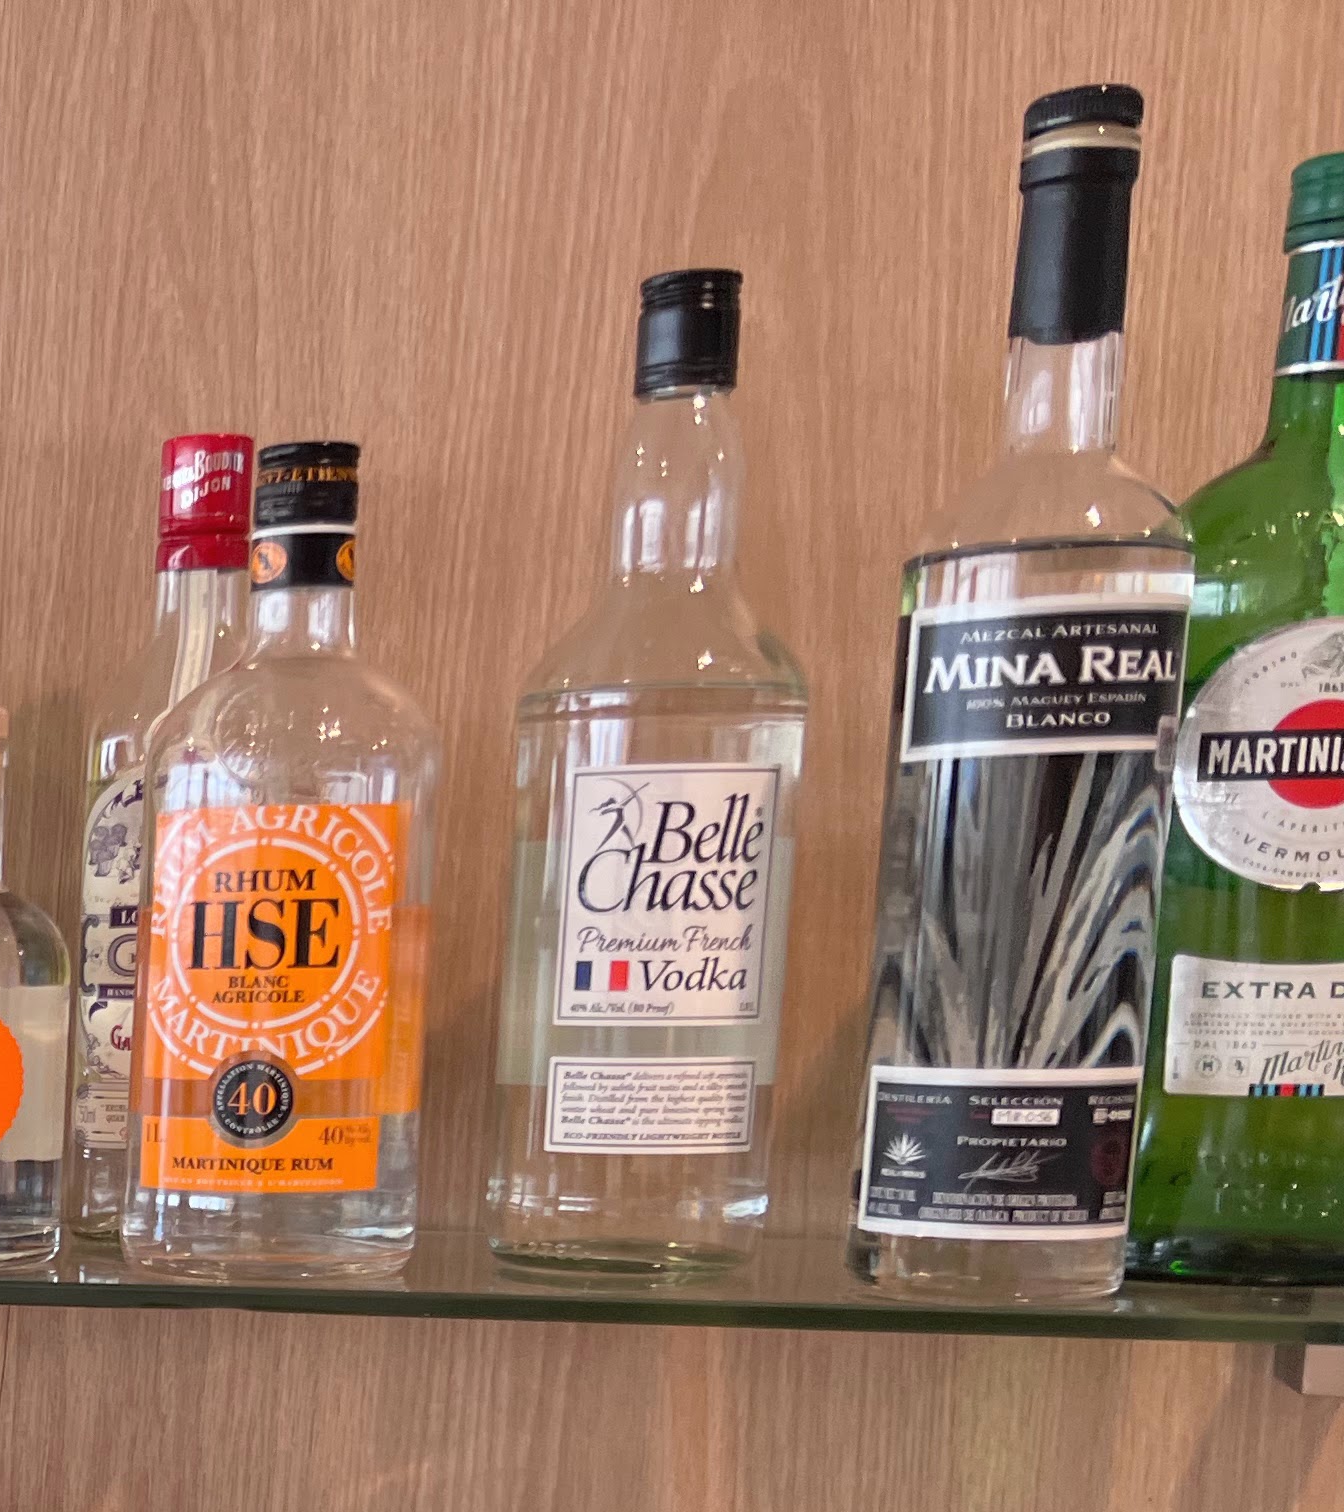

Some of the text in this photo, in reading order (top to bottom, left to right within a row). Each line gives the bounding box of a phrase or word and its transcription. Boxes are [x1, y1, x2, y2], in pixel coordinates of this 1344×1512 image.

[180, 474, 232, 510] DIJON
[961, 624, 1159, 644] MEZCAL ARTESANAL
[923, 646, 1176, 694] MINA REAL
[1012, 695, 1083, 706] MAGUEY
[1006, 711, 1111, 729] BLANCO
[1208, 735, 1344, 775] MARTINI
[650, 793, 765, 864] Belle
[214, 868, 317, 893] RHUM
[229, 805, 392, 935] AGRICOLE
[577, 842, 758, 914] Chasse
[187, 898, 340, 971] HSE
[577, 924, 752, 954] Premium French
[228, 976, 289, 989] BLANC
[638, 957, 747, 992] Vodka
[212, 990, 305, 1004] AGRICOLE
[1202, 982, 1316, 999] EXTRA
[152, 969, 381, 1061] MARTINIQUE
[227, 1082, 277, 1115] 40
[318, 1126, 343, 1146] 40
[957, 1135, 1068, 1148] PROPIETARIO
[173, 1157, 333, 1174] MARTINIQUE RUM
